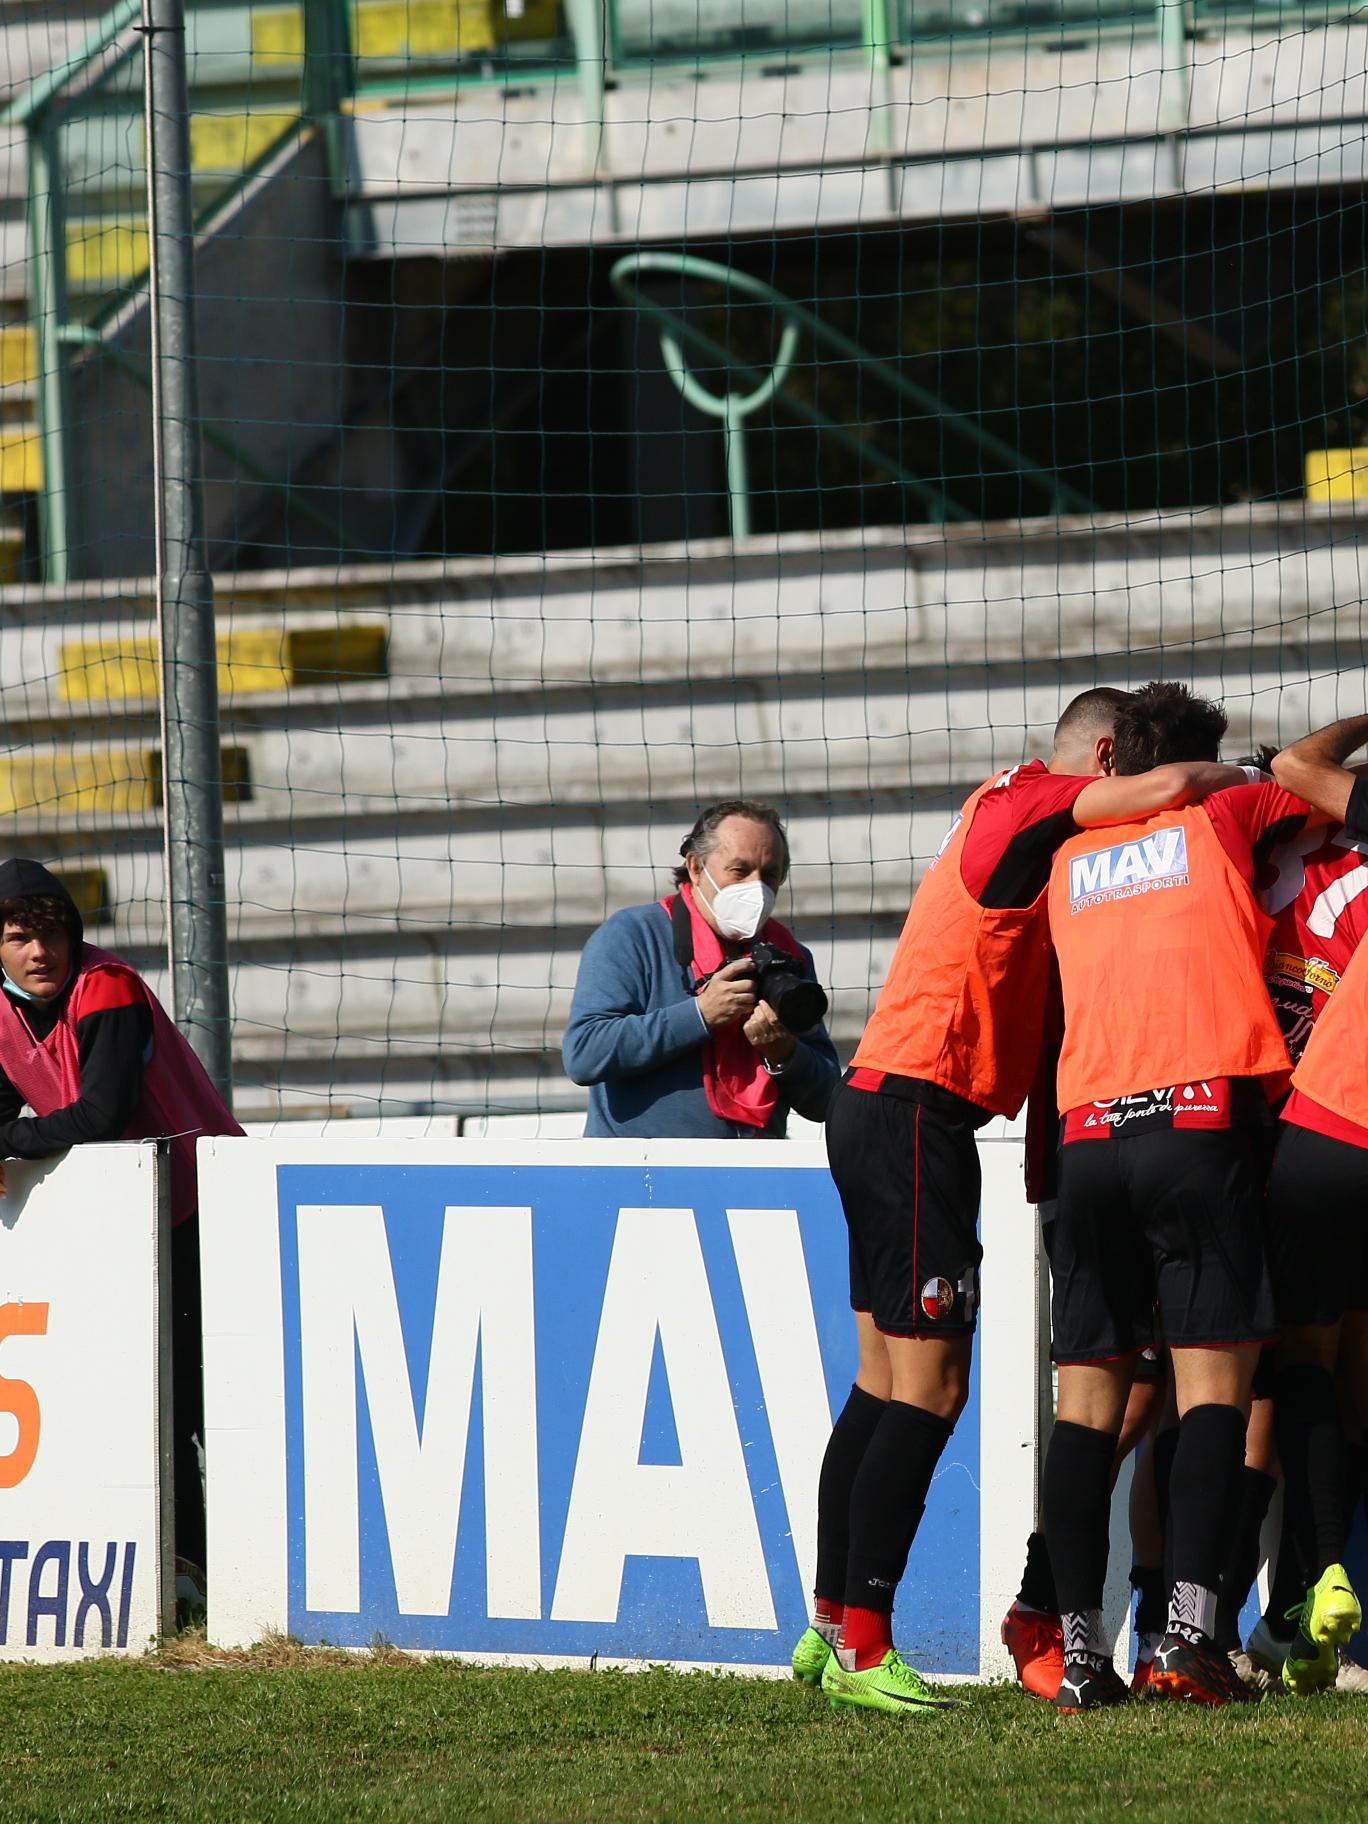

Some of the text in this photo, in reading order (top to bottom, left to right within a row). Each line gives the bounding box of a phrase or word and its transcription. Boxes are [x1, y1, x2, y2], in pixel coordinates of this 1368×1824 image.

[1071, 831, 1182, 900] MAV
[1071, 875, 1190, 915] AUTOTRASPORTI
[0, 1540, 137, 1649] TAXI
